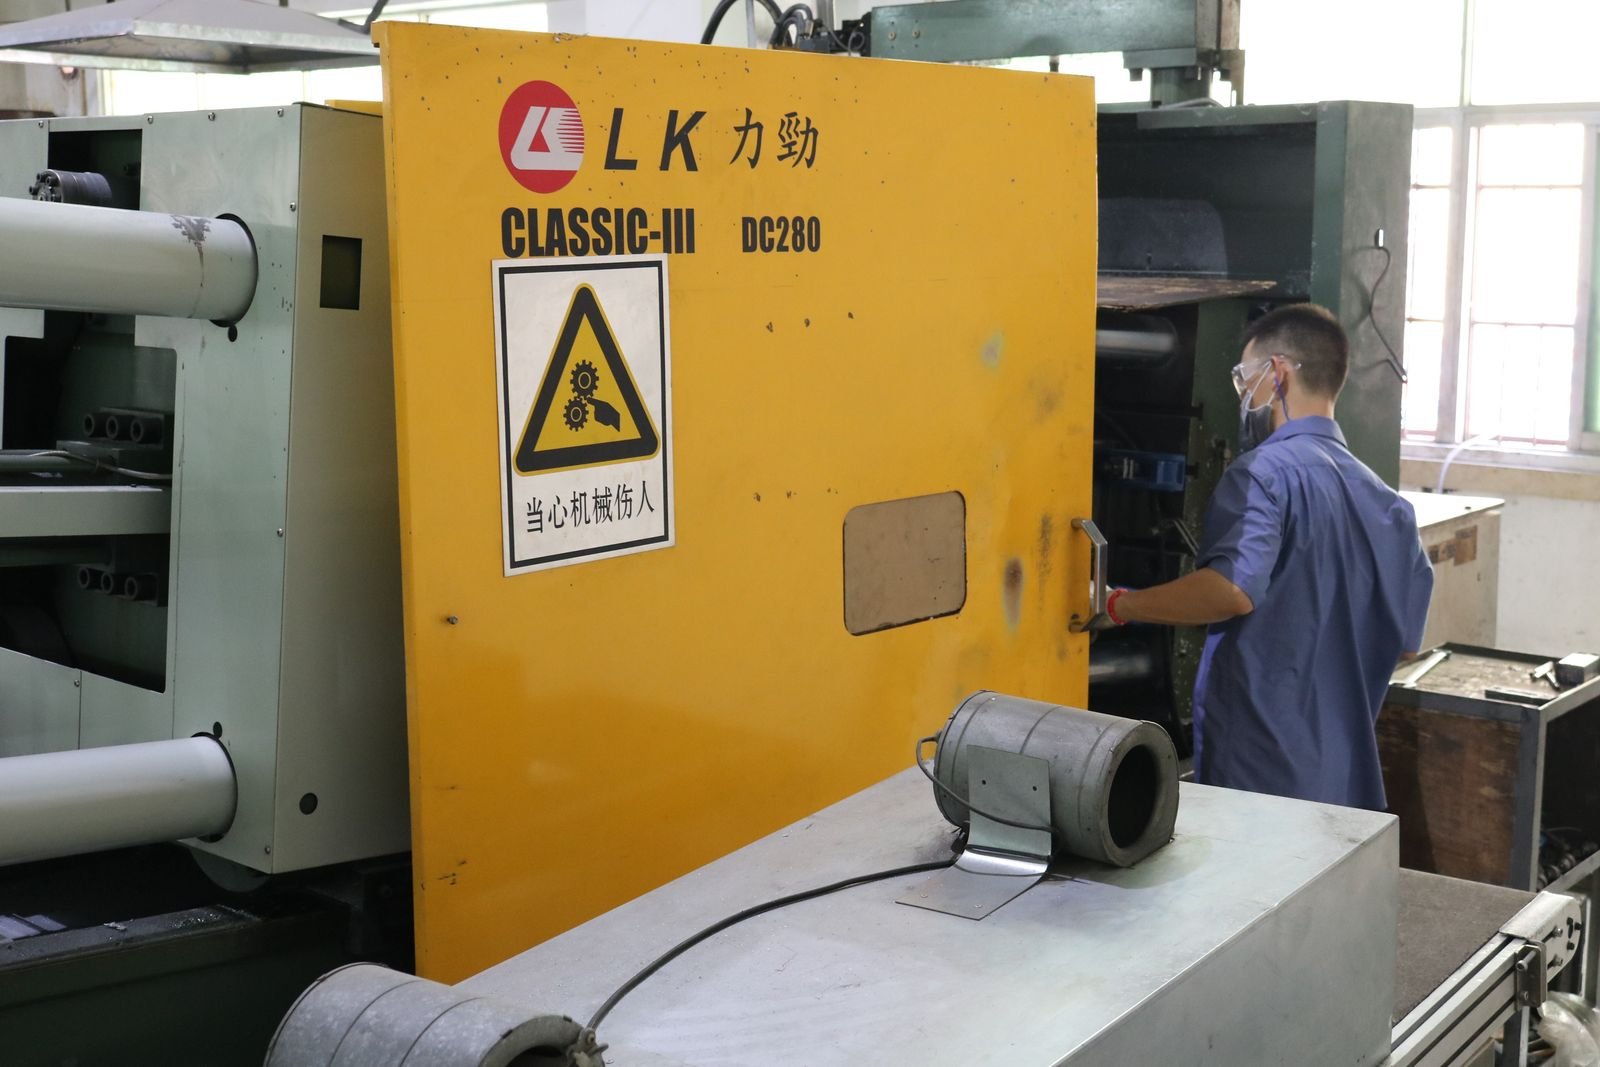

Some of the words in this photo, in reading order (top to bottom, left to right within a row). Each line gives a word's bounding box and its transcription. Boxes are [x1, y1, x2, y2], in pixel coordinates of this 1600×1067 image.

[729, 107, 819, 169] 力勁
[501, 207, 695, 258] CLASSIC-III
[741, 216, 821, 253] DC280
[526, 480, 655, 534] 当心机械伤人
